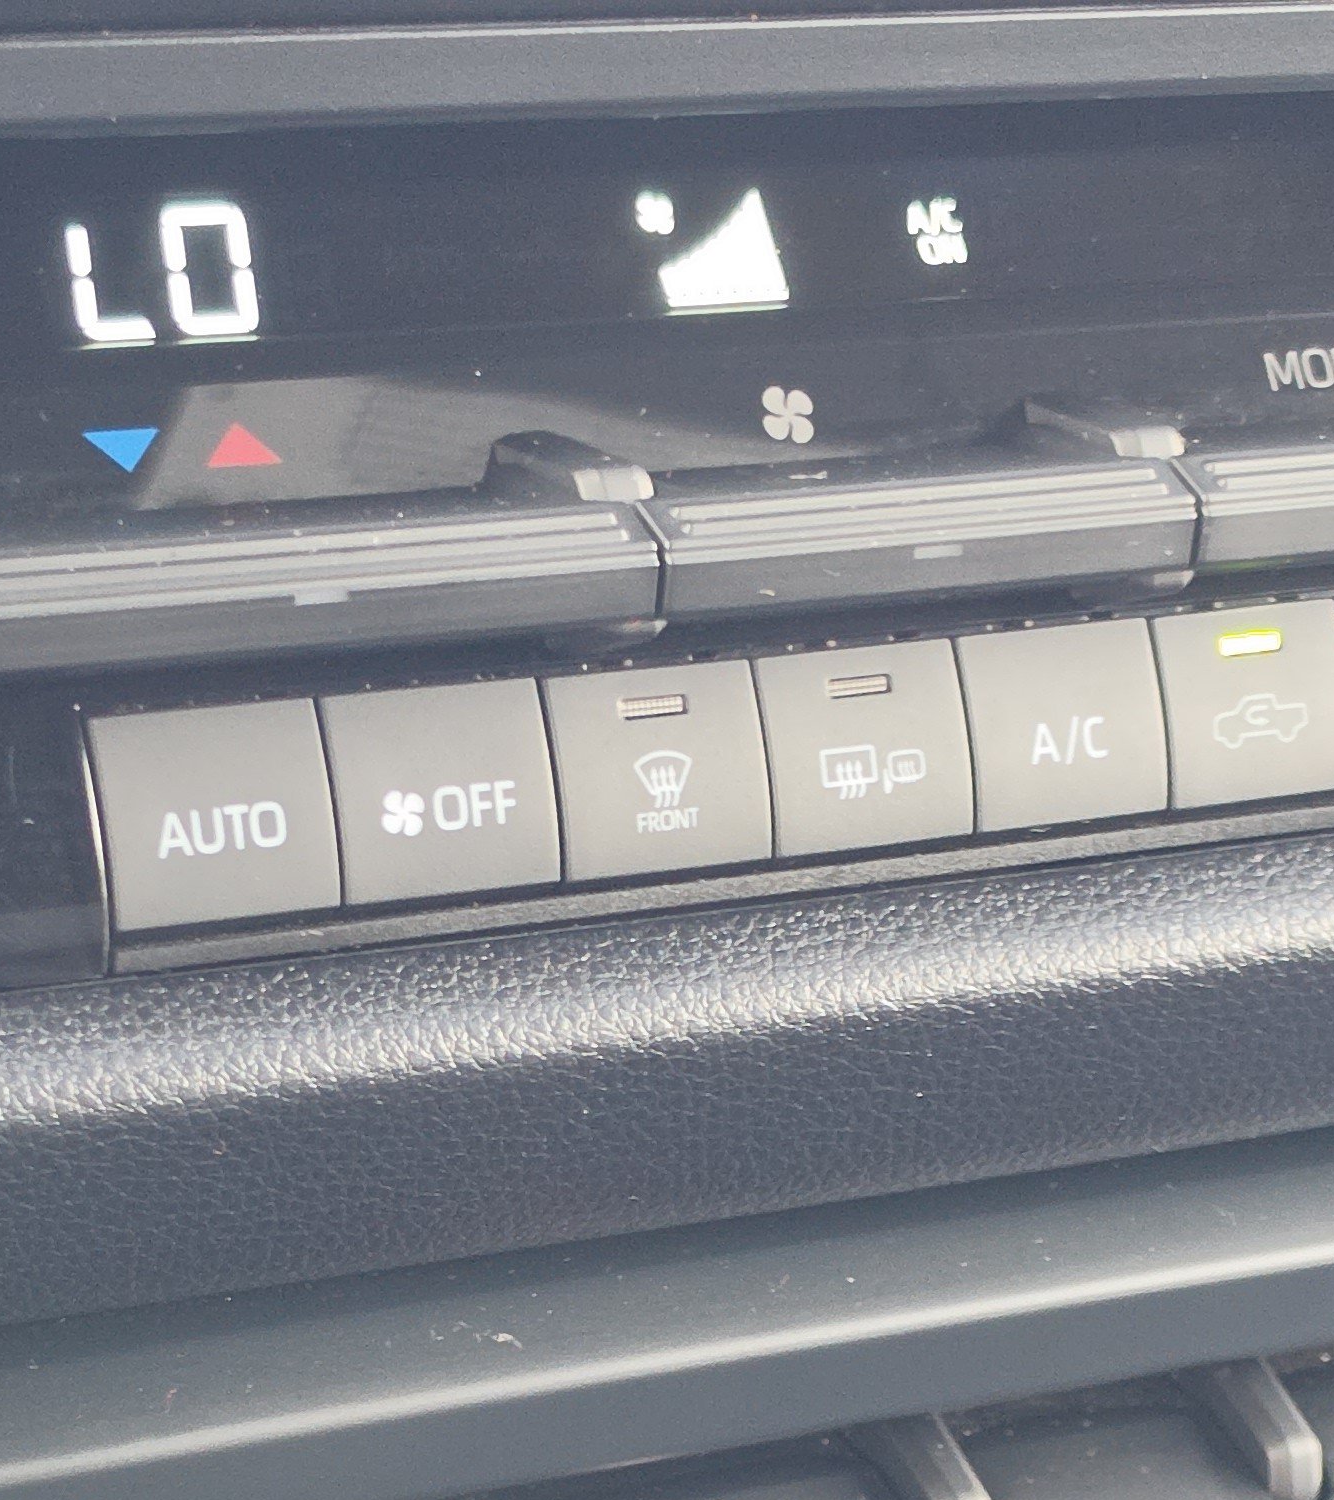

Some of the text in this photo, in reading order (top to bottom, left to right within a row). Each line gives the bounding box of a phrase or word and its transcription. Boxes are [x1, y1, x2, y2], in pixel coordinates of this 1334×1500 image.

[916, 233, 967, 265] ON
[1031, 715, 1109, 765] A/C
[157, 800, 287, 859] AUTO
[432, 779, 517, 832] OFF
[636, 806, 700, 834] FRONT
